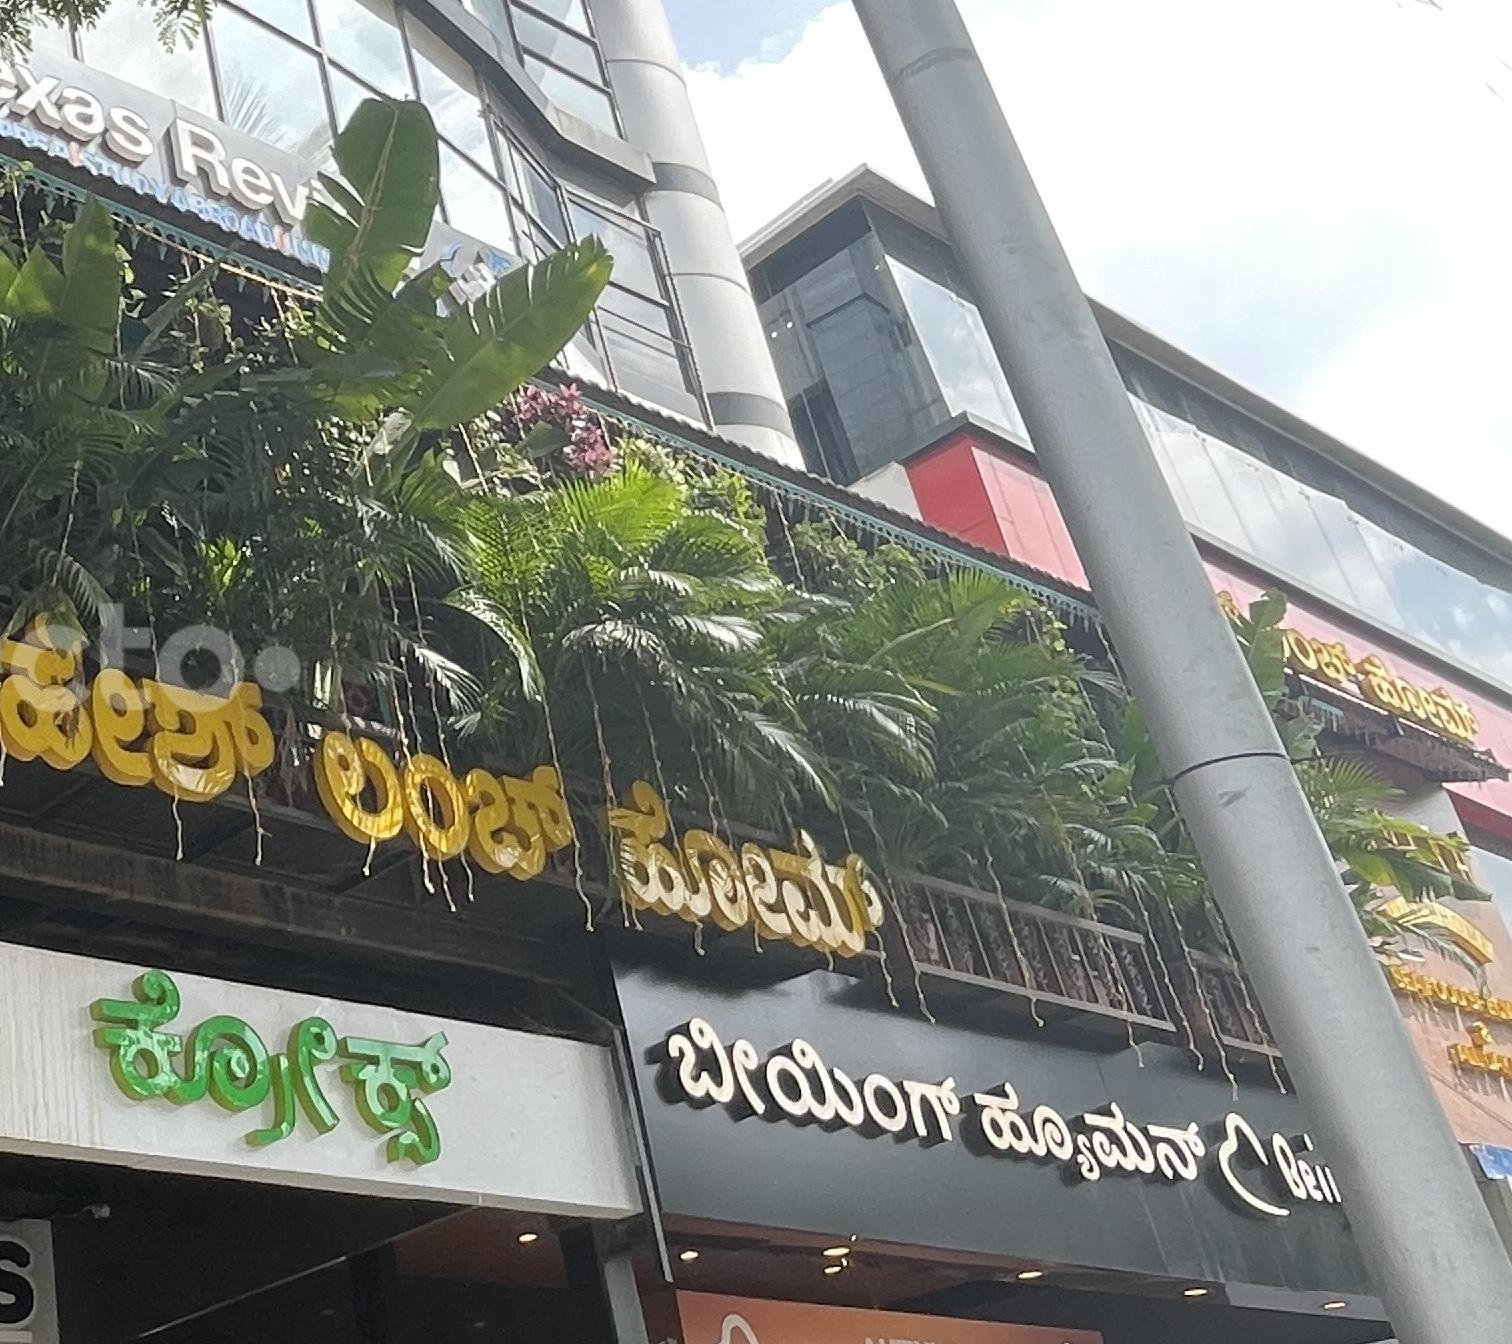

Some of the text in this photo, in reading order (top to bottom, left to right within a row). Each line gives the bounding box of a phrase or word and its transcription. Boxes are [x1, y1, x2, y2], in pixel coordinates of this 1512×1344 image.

[172, 118, 318, 231] Rev
[668, 1016, 1206, 1182] ಬೀಯಿಂಗ್ ಹ್ಯೂಮನ್
